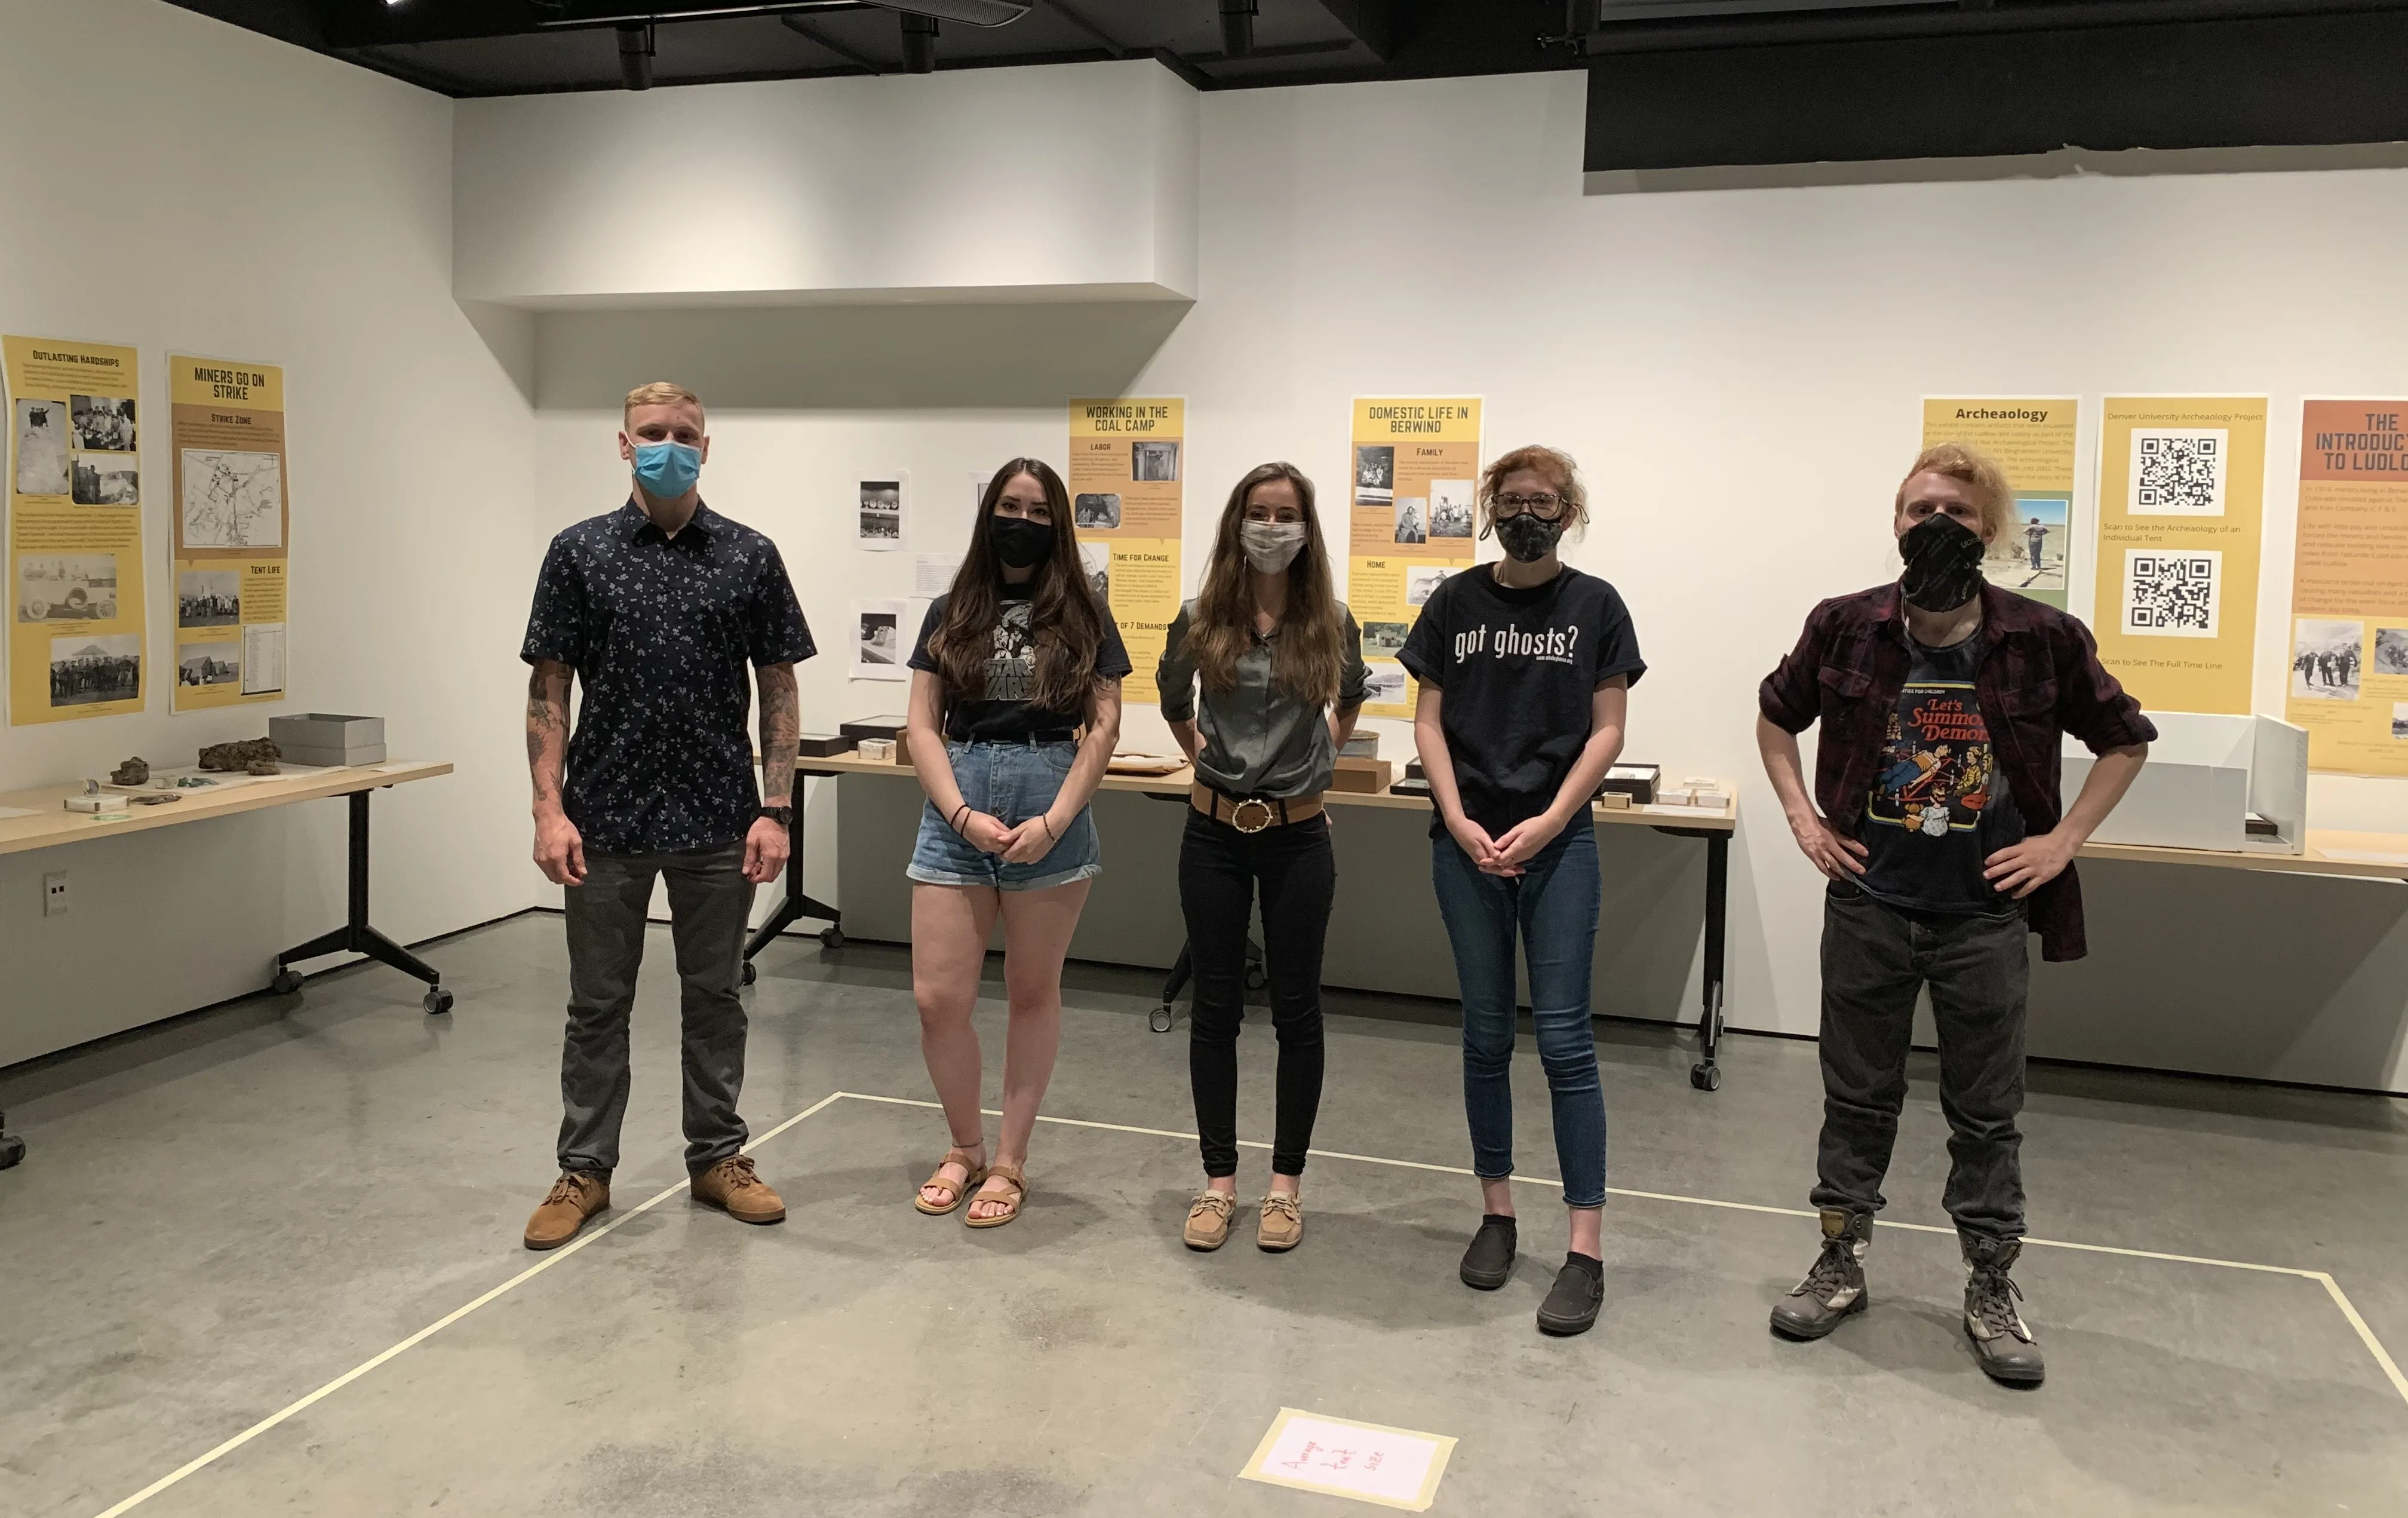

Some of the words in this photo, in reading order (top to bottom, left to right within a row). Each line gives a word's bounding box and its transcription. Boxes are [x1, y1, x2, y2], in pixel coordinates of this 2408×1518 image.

[33, 350, 78, 363] OUTLASTING
[81, 355, 119, 367] HARDSHIPS
[195, 367, 233, 384] MINERS
[236, 372, 249, 385] GO
[252, 373, 265, 387] ON
[214, 384, 248, 400] STRIKE
[1086, 406, 1132, 418] WORKING
[1136, 406, 1145, 418] IN
[1149, 406, 1168, 418] THE
[1369, 406, 1424, 419] DOMESTIC
[1428, 406, 1453, 419] LIFE
[1457, 406, 1468, 419] IN
[1955, 409, 2048, 422] Archeaology
[2139, 413, 2179, 421] University
[2181, 413, 2232, 422] Archeaology
[2234, 413, 2263, 422] Project
[211, 413, 234, 424] STRIKE
[235, 415, 251, 425] ZONE
[1095, 419, 1122, 431] COAL
[1125, 419, 1154, 431] CAMP
[2365, 413, 2400, 431] THE
[1390, 420, 1441, 433] BERWIND
[2315, 433, 2408, 451] INTRODUC
[1416, 447, 1443, 456] FAMILY
[2324, 453, 2345, 470] TO
[2167, 525, 2217, 534] Archeaology
[2219, 525, 2228, 533] of
[251, 566, 266, 574] TENT
[268, 565, 281, 574] LIFE
[1367, 560, 1386, 569] HOME
[1137, 622, 1167, 630] DEMANDS
[1455, 624, 1486, 664] got
[1494, 624, 1578, 658] ghosts?
[1927, 698, 1964, 712] Let's
[1907, 707, 1985, 727] Summo
[1281, 1441, 1324, 1472] Average
[1320, 1449, 1357, 1470] tent
